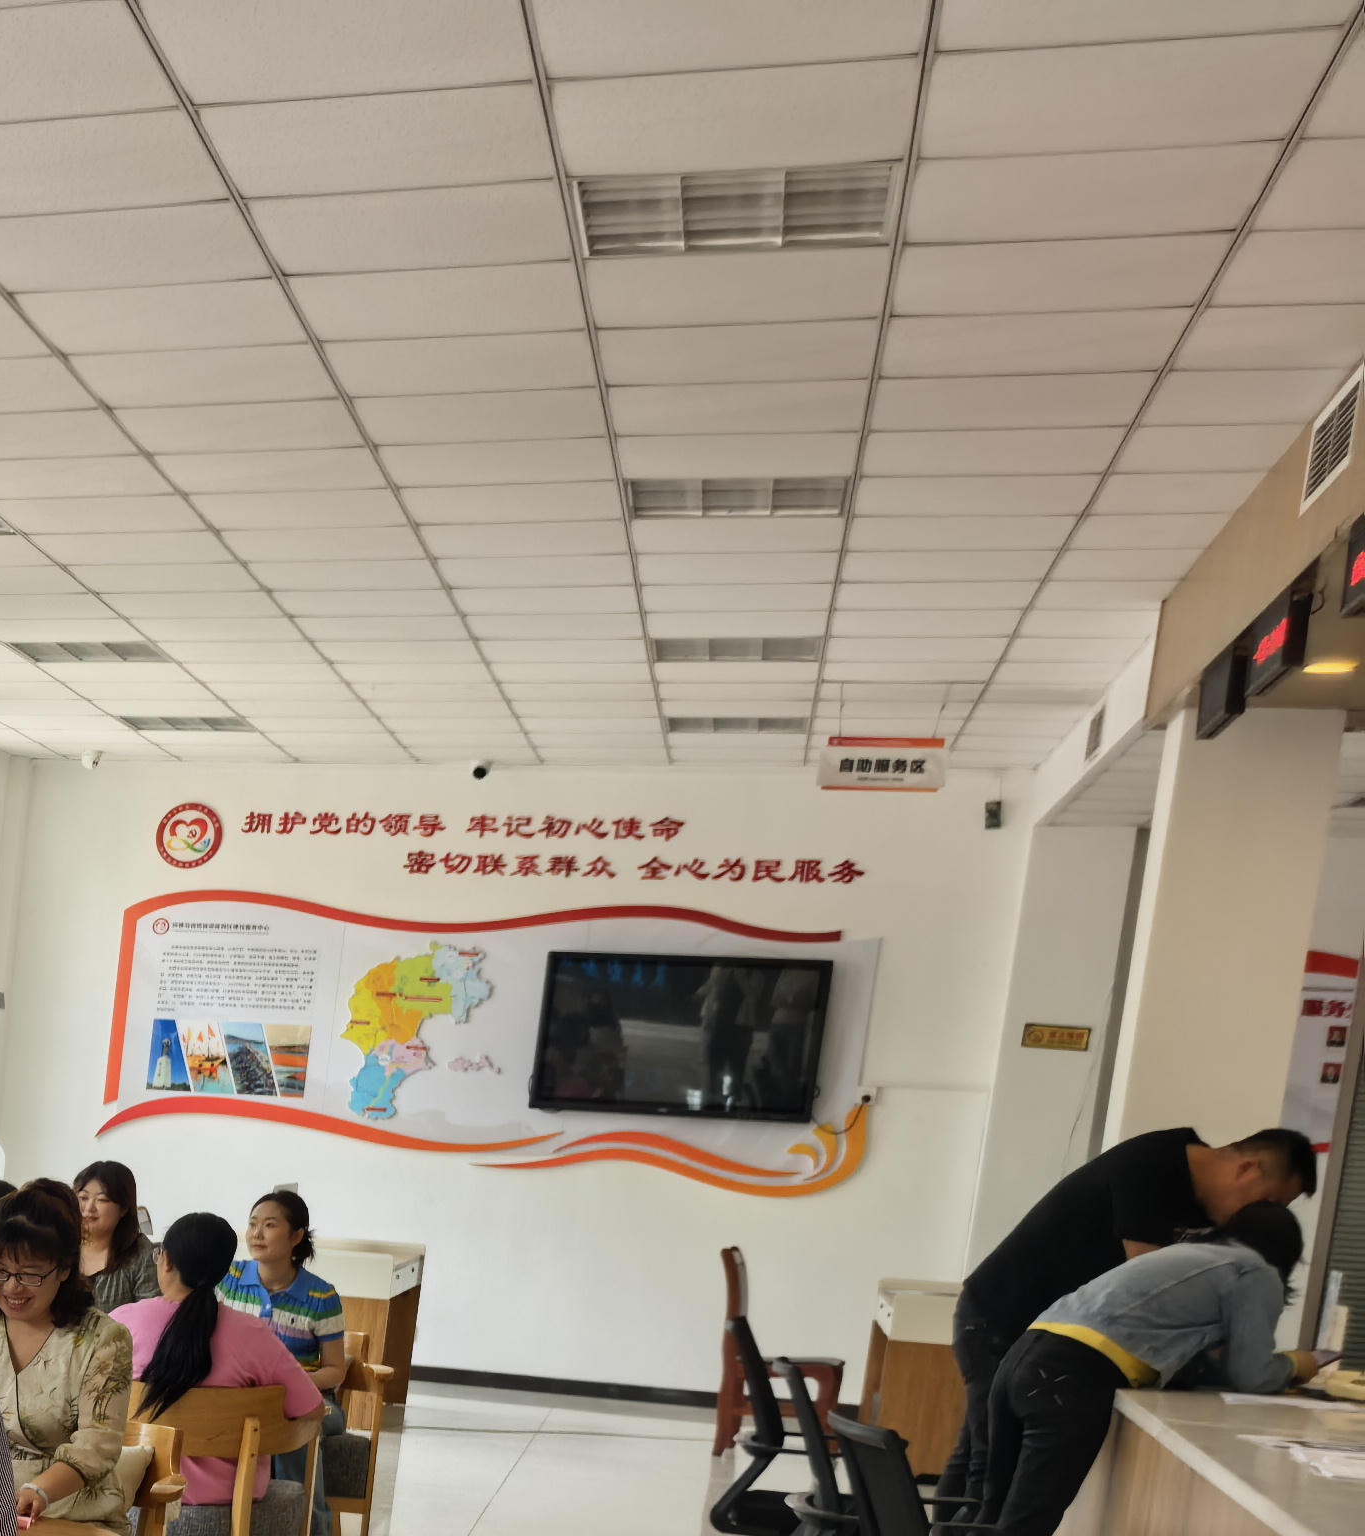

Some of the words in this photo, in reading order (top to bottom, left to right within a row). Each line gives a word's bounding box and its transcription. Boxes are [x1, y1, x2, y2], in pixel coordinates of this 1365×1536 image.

[839, 758, 925, 774] 自助服务区
[241, 811, 446, 837] 拥护党的领导
[466, 813, 686, 841] 牢记初心使命
[403, 850, 617, 879] 密切联系群众
[636, 856, 866, 885] 全心为民服务
